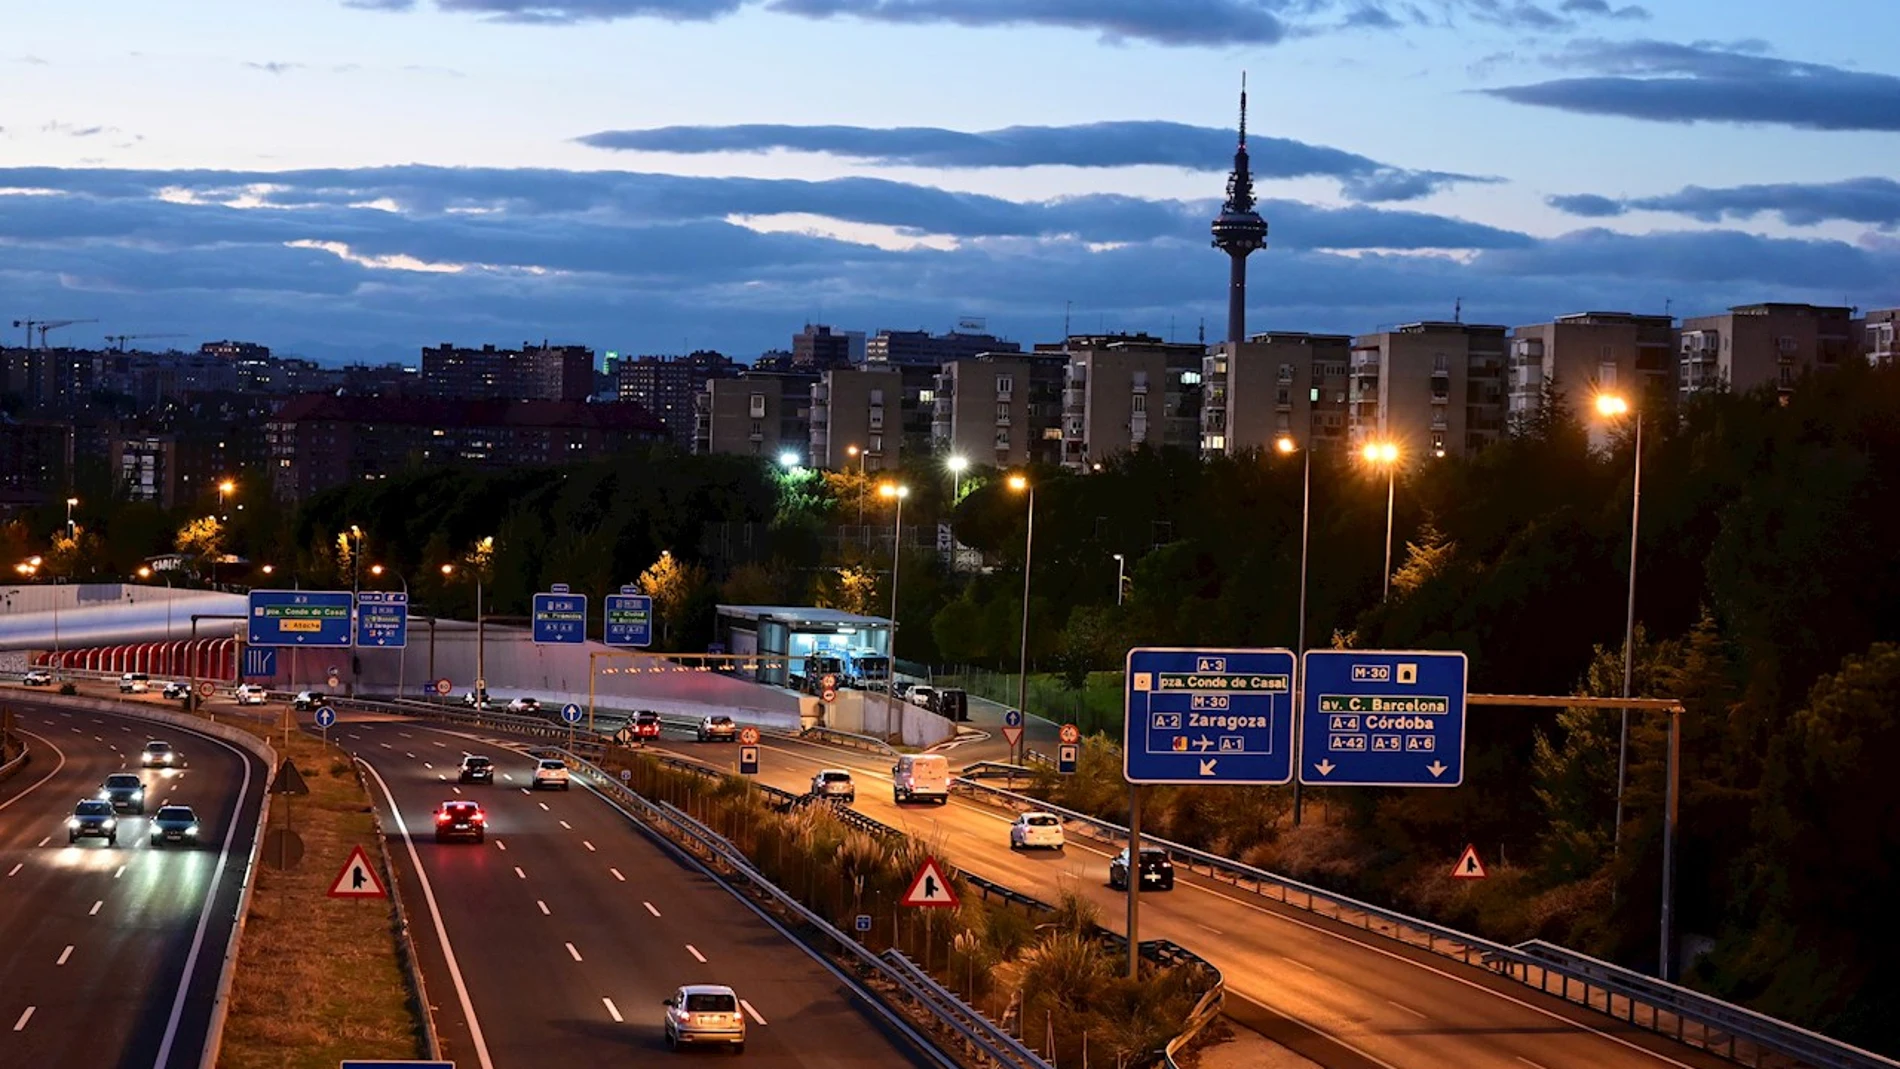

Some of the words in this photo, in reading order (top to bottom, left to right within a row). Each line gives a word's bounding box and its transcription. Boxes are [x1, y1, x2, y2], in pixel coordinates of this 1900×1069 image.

[284, 607, 309, 616] Conde
[311, 608, 322, 616] de
[324, 608, 347, 616] Casal
[1199, 659, 1224, 671] A-3
[1354, 667, 1388, 678] M-30
[1160, 678, 1185, 690] pza.
[1187, 676, 1227, 689] Conde
[1230, 677, 1247, 689] de
[1250, 677, 1288, 689] Casal
[1193, 697, 1227, 708] M-30
[1322, 700, 1343, 711] av.
[1349, 698, 1366, 711] C.
[1372, 699, 1445, 712] Barcelona
[1155, 715, 1180, 727] A-2
[1188, 713, 1267, 731] Zaragoza
[1332, 717, 1358, 729] A-4
[1365, 715, 1434, 730] Córdoba
[1222, 738, 1242, 750] A-1
[1332, 737, 1364, 749] A-42
[1375, 737, 1399, 749] A-5
[1408, 737, 1432, 749] A-6
